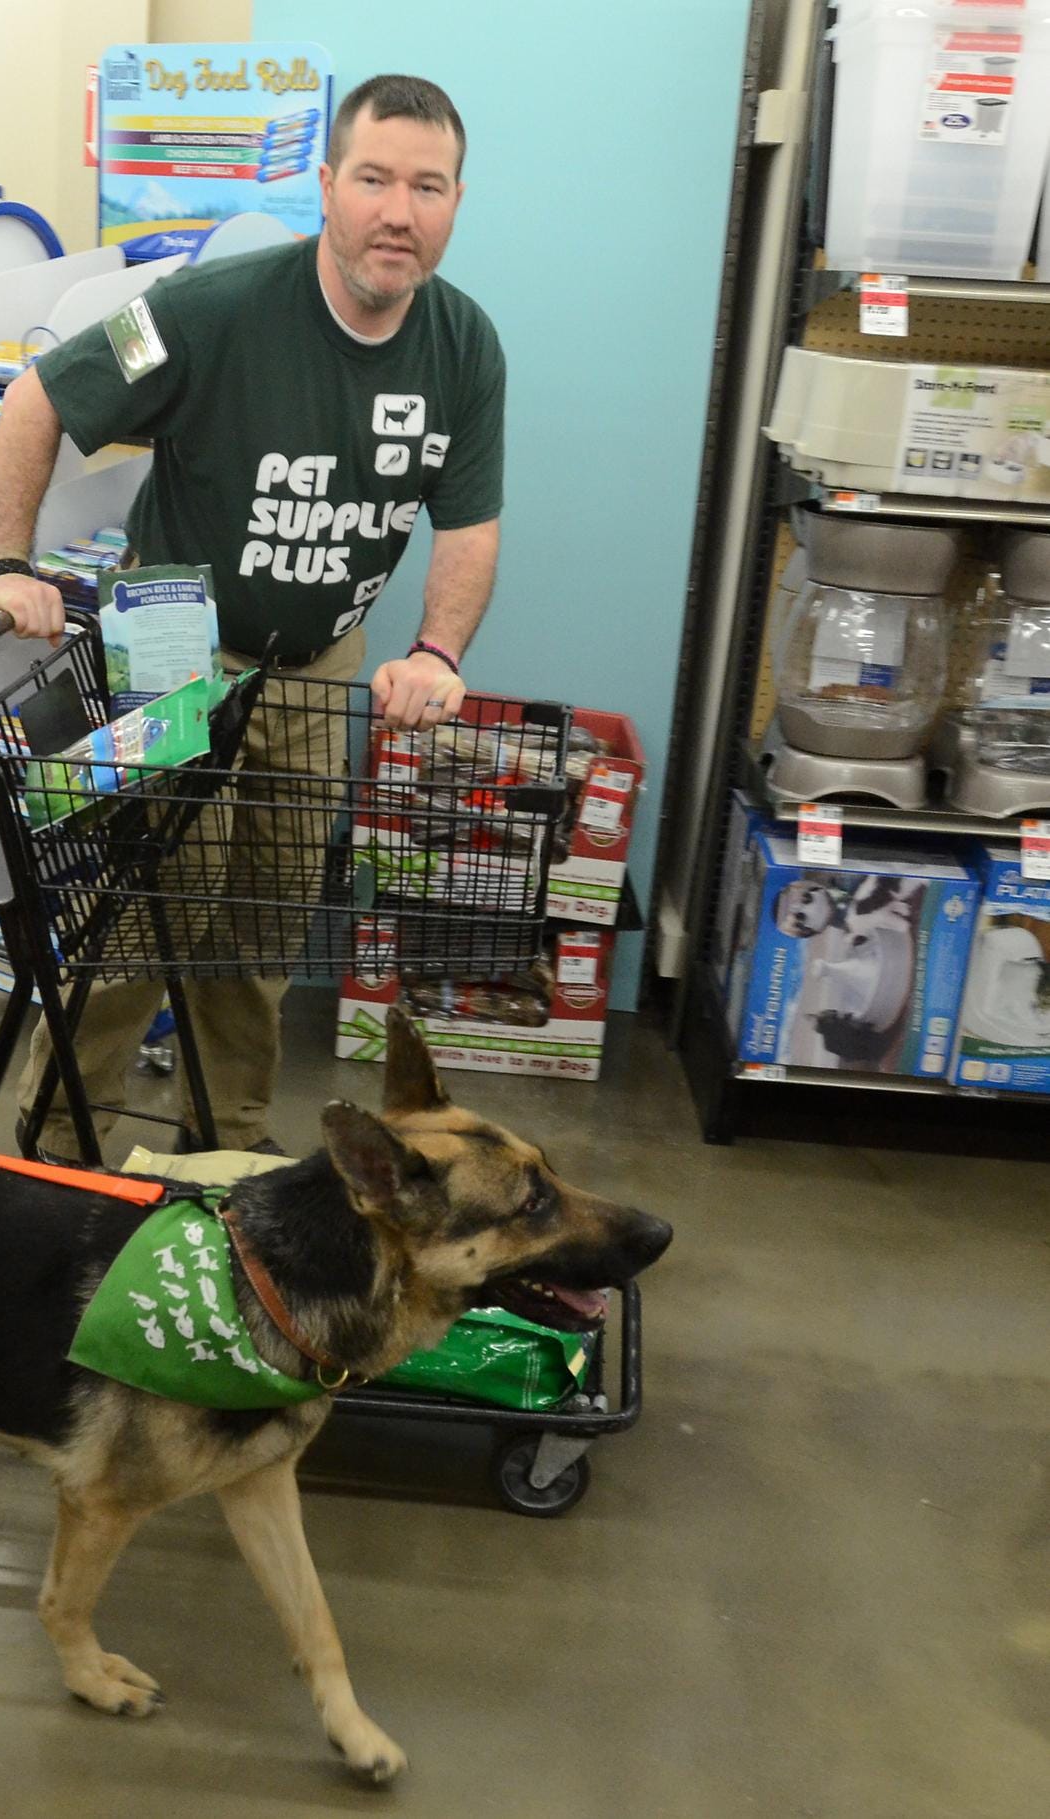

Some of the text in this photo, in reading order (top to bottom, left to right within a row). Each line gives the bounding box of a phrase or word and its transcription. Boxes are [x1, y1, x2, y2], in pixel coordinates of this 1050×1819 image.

[145, 58, 188, 99] Dog
[193, 57, 251, 92] Food
[255, 56, 322, 95] Rolls
[255, 452, 338, 497] PET
[247, 497, 420, 541] SUPPLIE
[126, 586, 154, 598] BROWN
[154, 583, 169, 593] RICE
[140, 593, 177, 605] FORMULA
[764, 947, 788, 1021] FOUNTAIN
[470, 1053, 503, 1064] love
[510, 1056, 525, 1066] to
[529, 1059, 555, 1071] my
